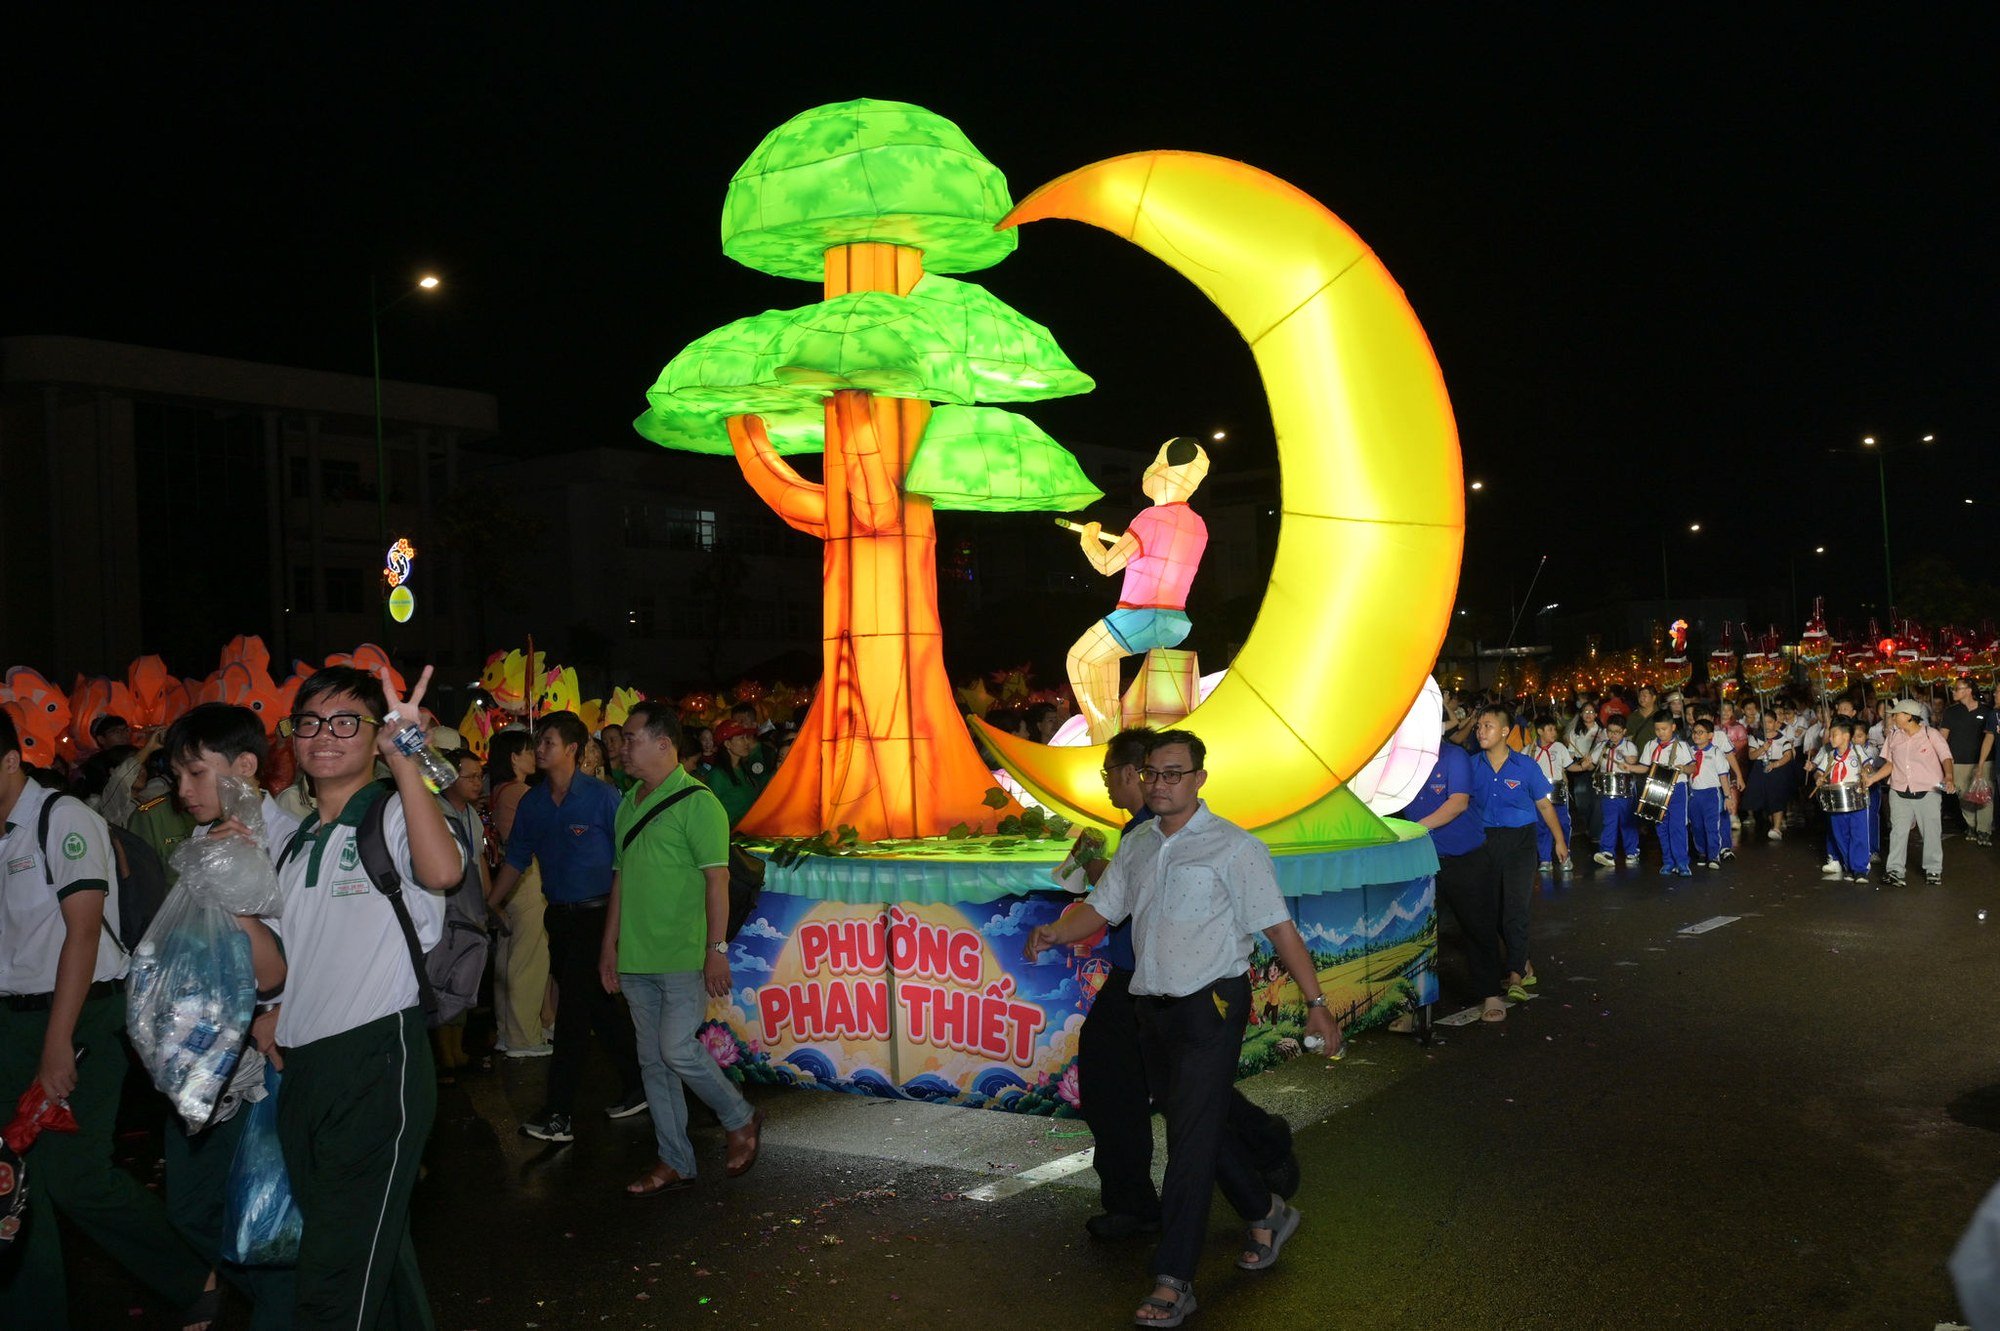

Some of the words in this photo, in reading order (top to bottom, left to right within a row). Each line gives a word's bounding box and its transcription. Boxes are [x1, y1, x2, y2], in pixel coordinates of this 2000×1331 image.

[799, 907, 980, 982] PHƯỜNG
[757, 981, 888, 1040] PHAN
[899, 976, 1043, 1062] THIẾT
